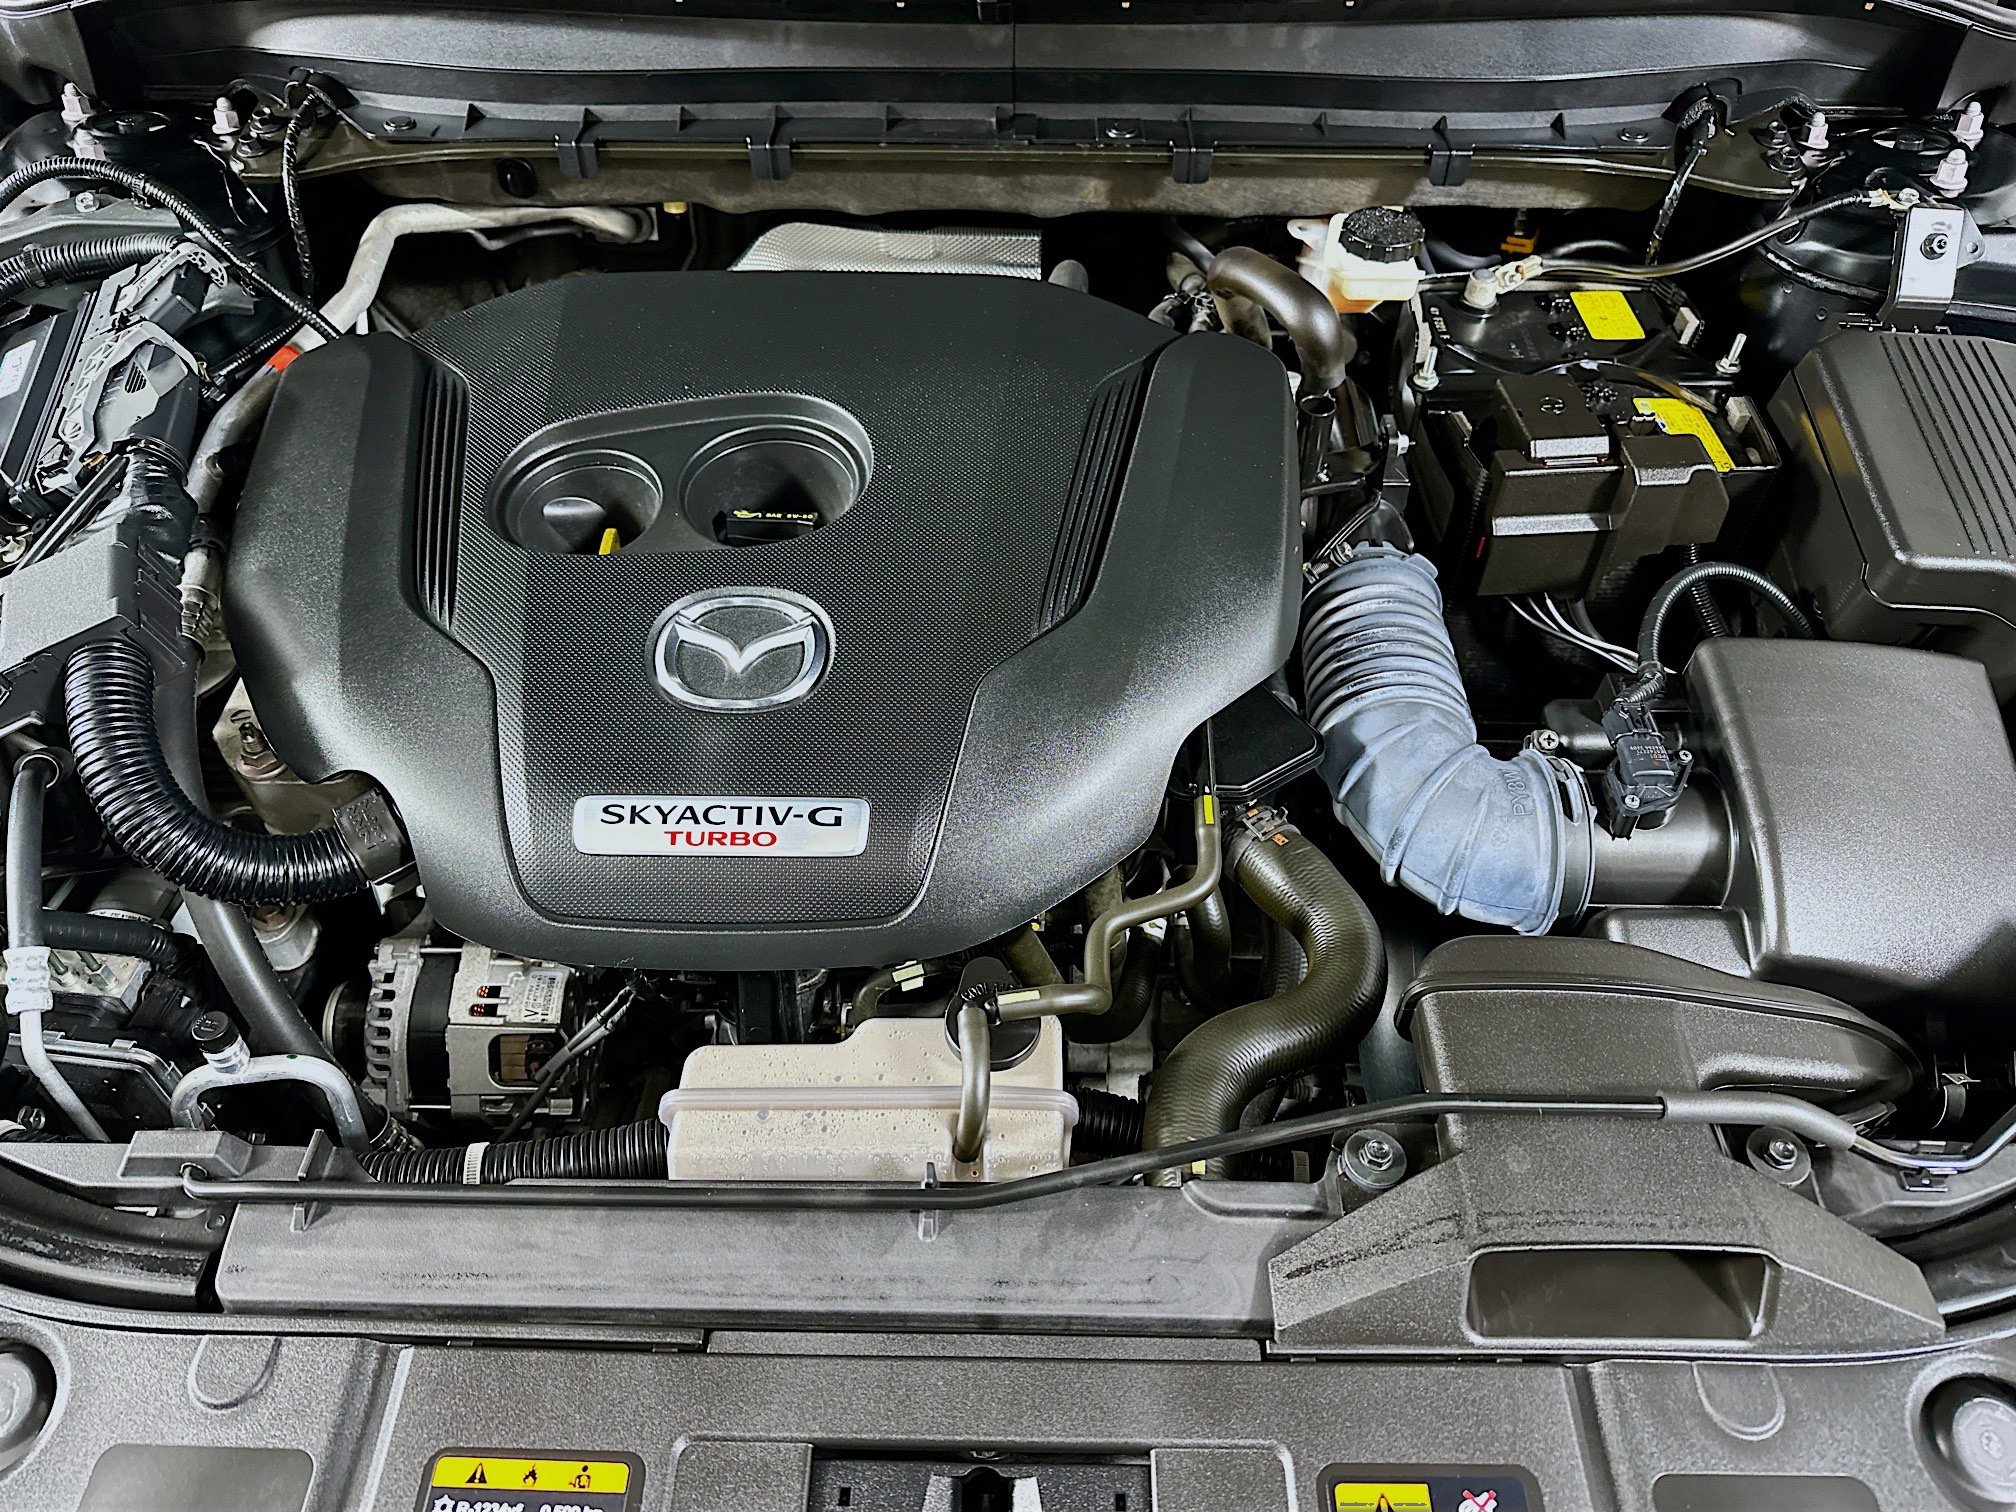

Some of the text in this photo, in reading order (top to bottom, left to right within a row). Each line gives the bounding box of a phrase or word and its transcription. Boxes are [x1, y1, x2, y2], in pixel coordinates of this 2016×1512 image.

[1498, 768, 1533, 816] PY8W
[600, 803, 843, 828] SKYACTIV-G
[664, 830, 778, 848] TURBO
